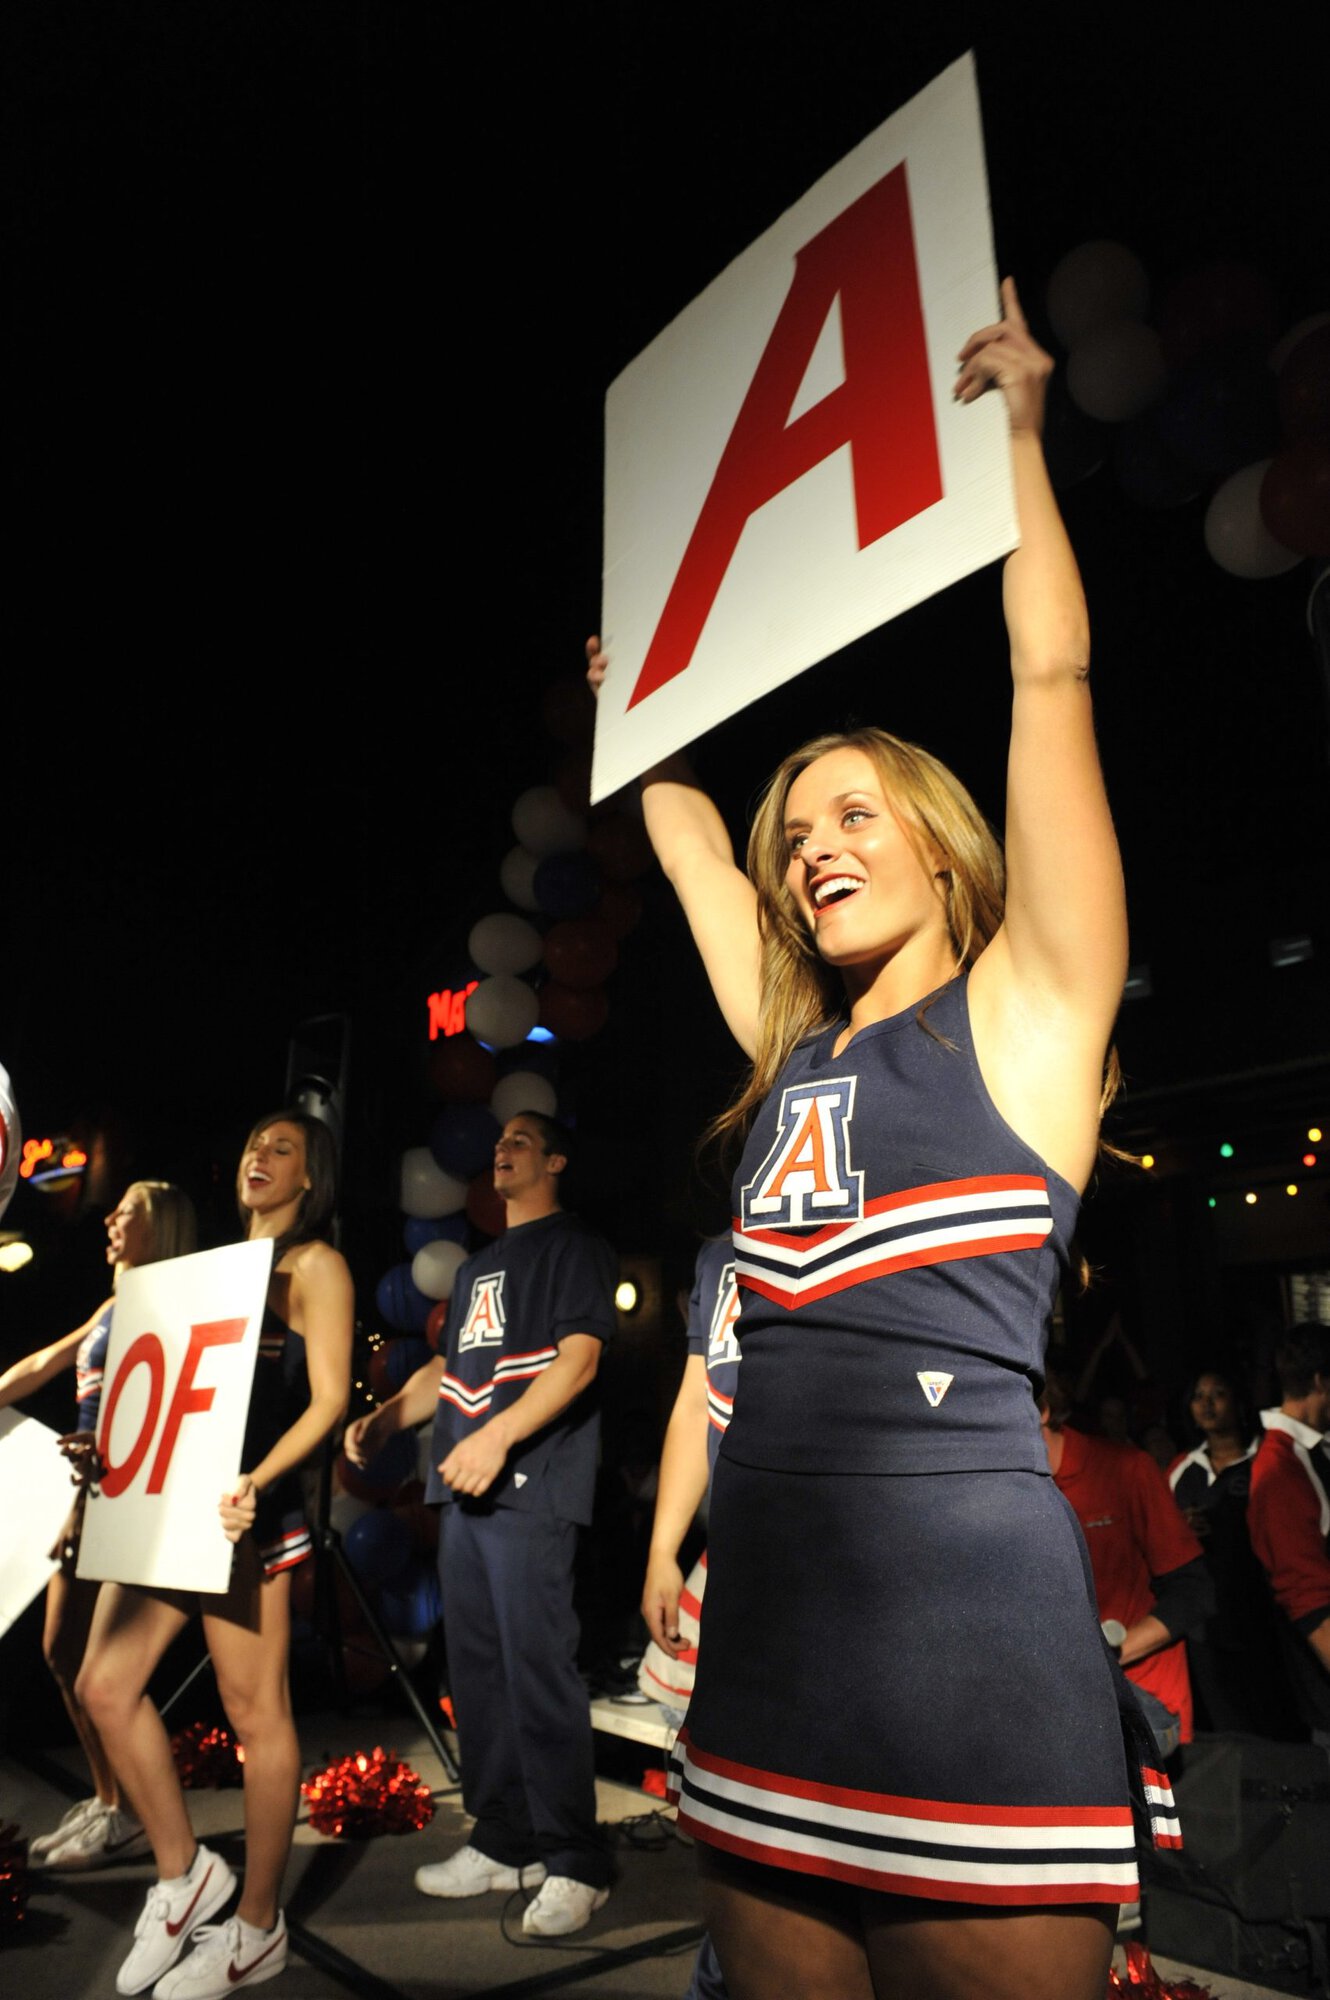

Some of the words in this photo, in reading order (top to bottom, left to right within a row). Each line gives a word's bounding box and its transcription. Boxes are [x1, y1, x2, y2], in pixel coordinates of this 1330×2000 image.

[626, 159, 944, 714] A
[741, 1075, 865, 1232] A
[458, 1270, 506, 1353] A
[96, 1317, 249, 1498] OF
